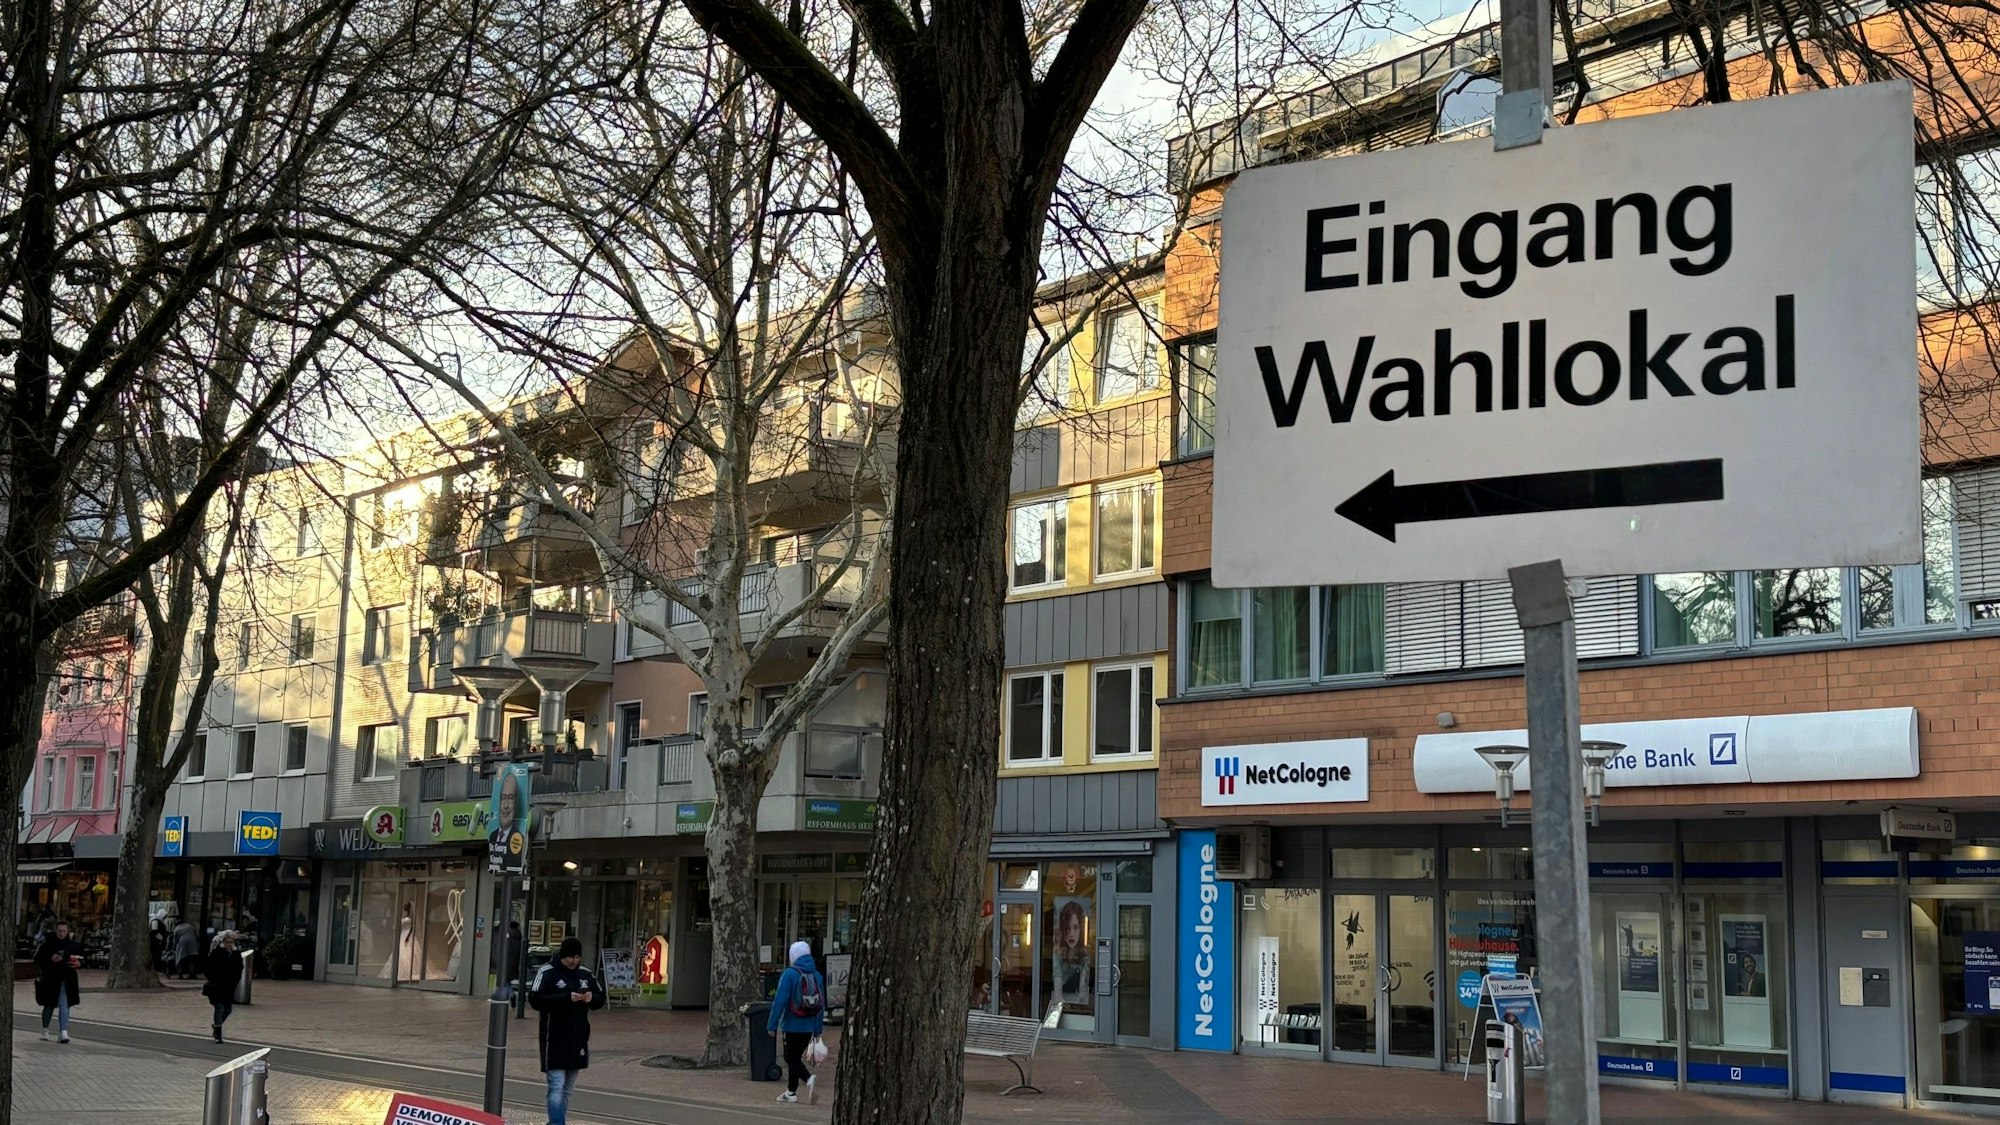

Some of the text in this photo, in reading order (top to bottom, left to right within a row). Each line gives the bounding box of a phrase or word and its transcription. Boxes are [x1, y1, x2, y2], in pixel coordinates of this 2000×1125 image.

[1304, 183, 1734, 299] Eingang
[1254, 294, 1796, 428] Wahllokal
[1644, 747, 1696, 768] Bank
[1246, 762, 1352, 788] NetCologne
[676, 822, 707, 832] REFORMHA
[807, 820, 856, 830] REFORMHAUS
[1898, 821, 1941, 832] Deutsche Bank
[165, 829, 181, 843] TEDi
[243, 825, 278, 840] TEDi
[1956, 866, 1985, 874] Deutsche
[1194, 843, 1218, 1036] NetCologne
[1607, 1061, 1644, 1071] Deutsche Bank
